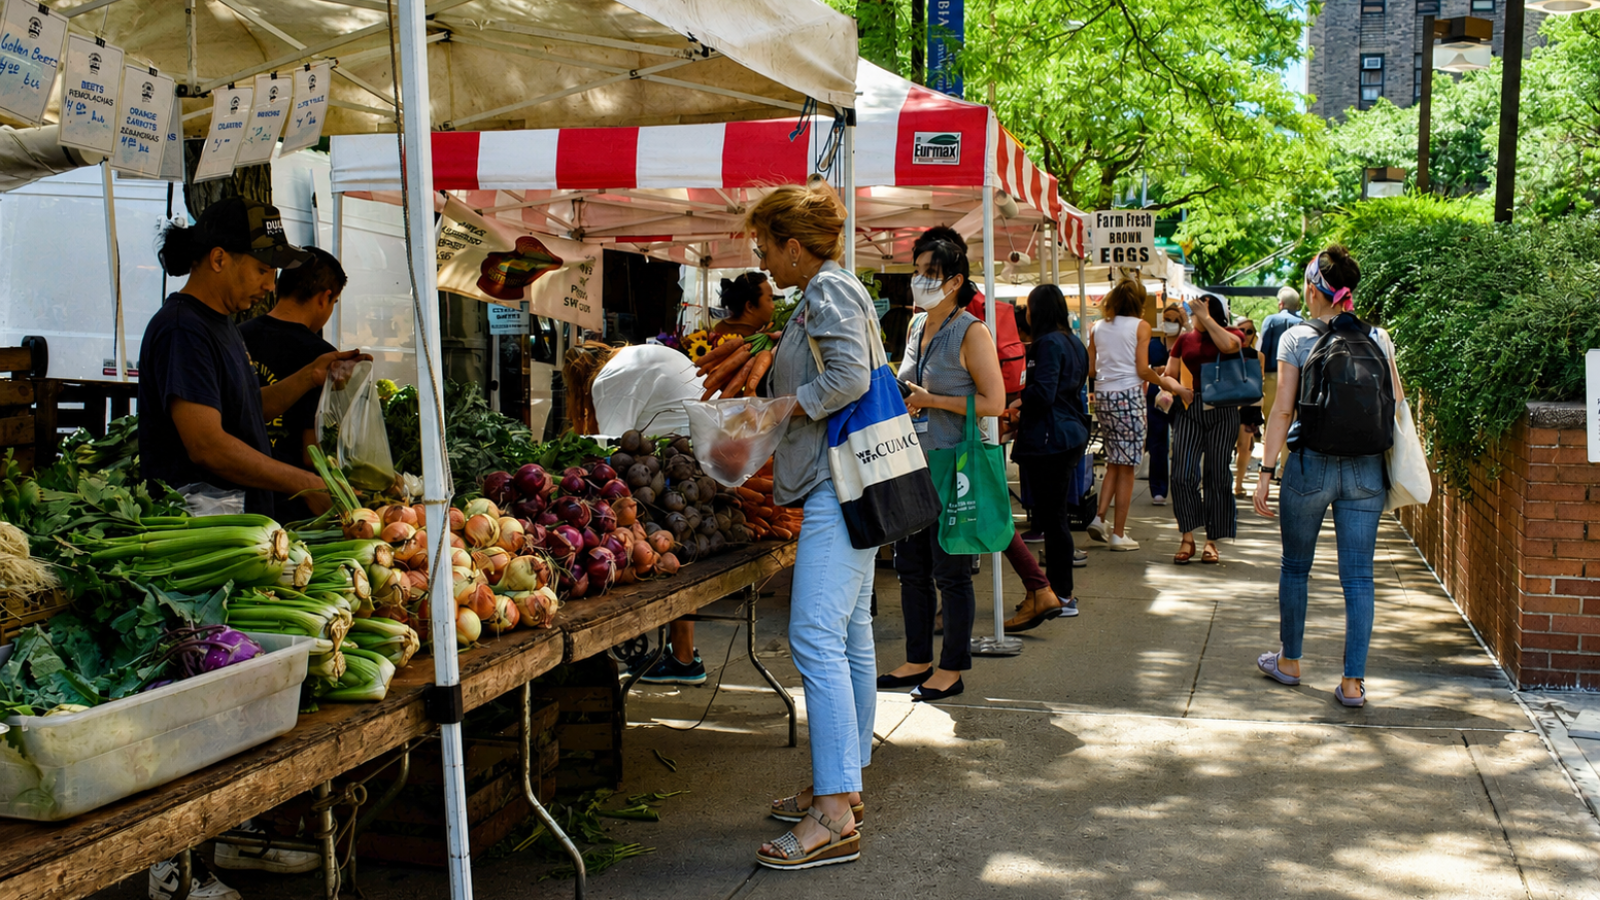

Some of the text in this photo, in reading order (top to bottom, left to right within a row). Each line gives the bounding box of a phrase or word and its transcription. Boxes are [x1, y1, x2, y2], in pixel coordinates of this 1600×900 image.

[81, 80, 105, 94] BEETS
[69, 88, 114, 106] REMOLACHAS
[130, 107, 157, 121] ORANGE
[914, 143, 956, 157] Eurmax
[1097, 212, 1152, 228] Farm Fresh
[1109, 231, 1142, 244] BROWN
[1101, 246, 1150, 263] EGGS
[875, 432, 918, 457] CUMC
